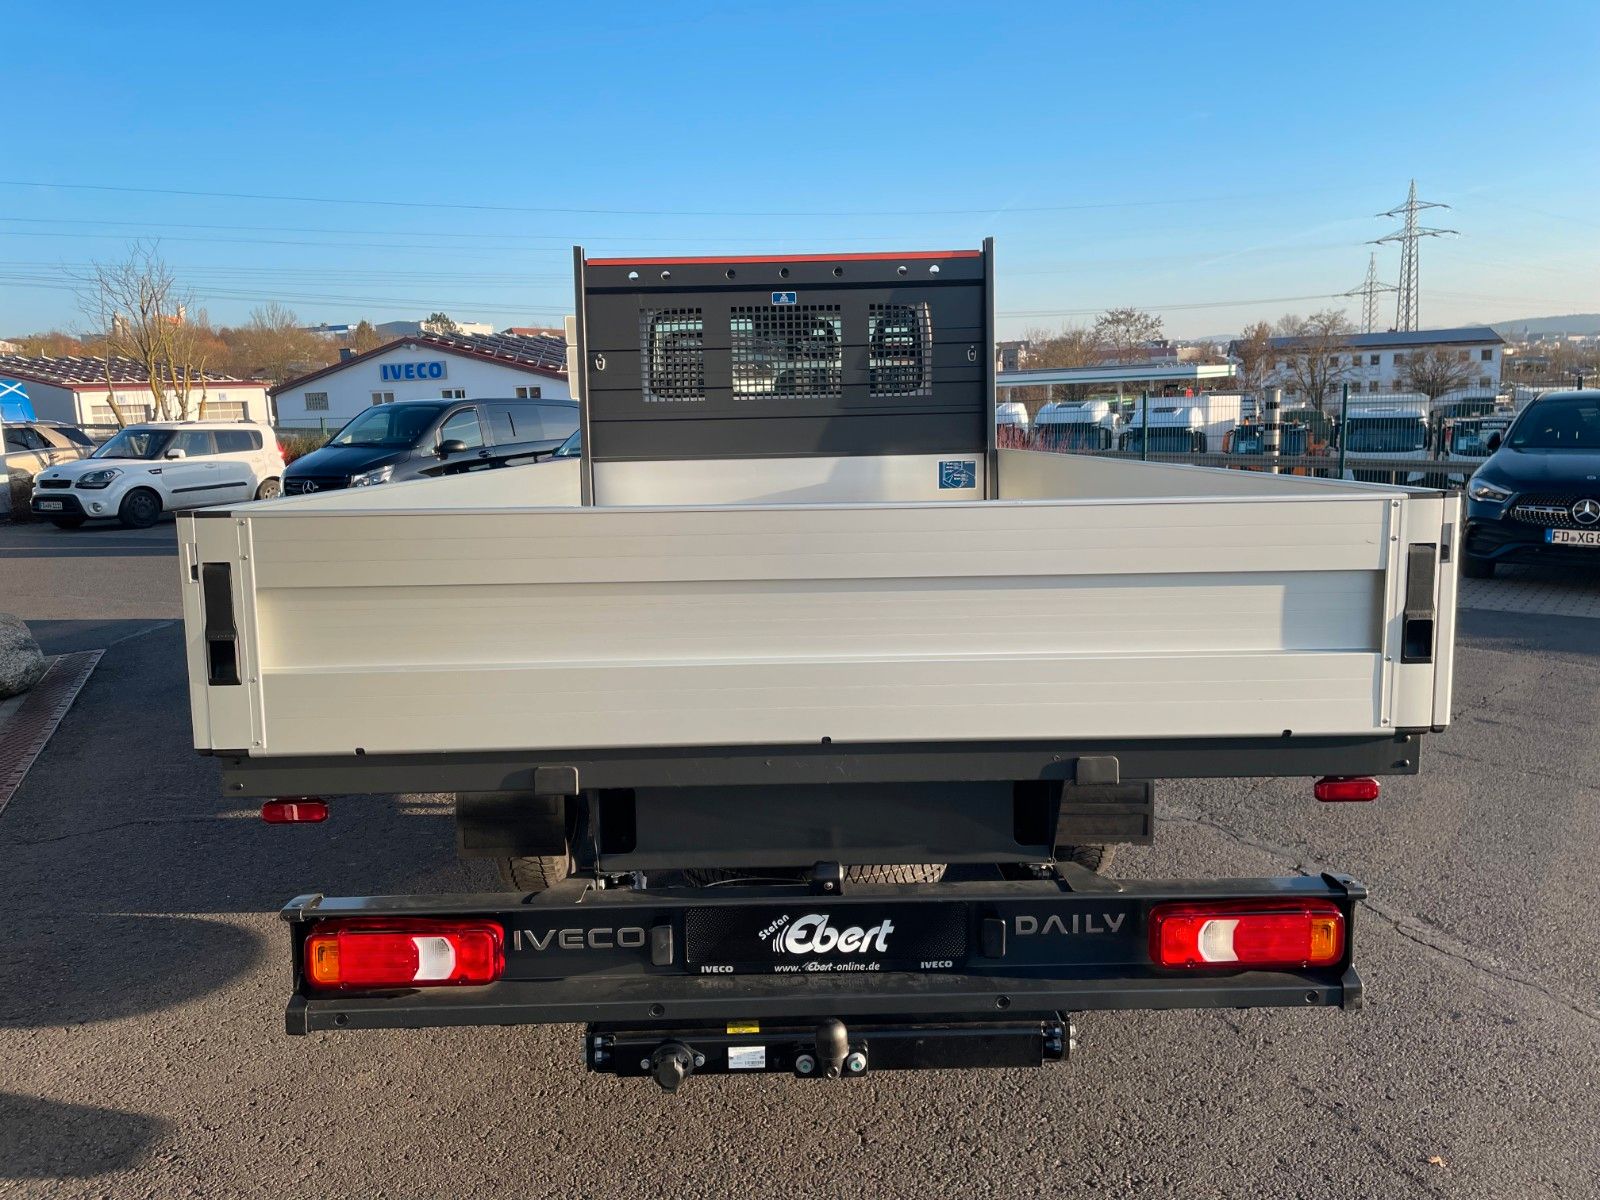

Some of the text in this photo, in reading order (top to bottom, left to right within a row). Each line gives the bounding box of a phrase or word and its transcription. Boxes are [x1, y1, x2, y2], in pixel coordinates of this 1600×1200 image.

[383, 362, 442, 380] IVECO
[1552, 531, 1570, 542] FD
[758, 914, 790, 941] Stefan
[785, 913, 895, 954] Ebert
[1015, 913, 1125, 936] DAILY
[513, 927, 645, 951] IVECO
[701, 965, 734, 973] IVECO
[920, 960, 953, 969] IVECO
